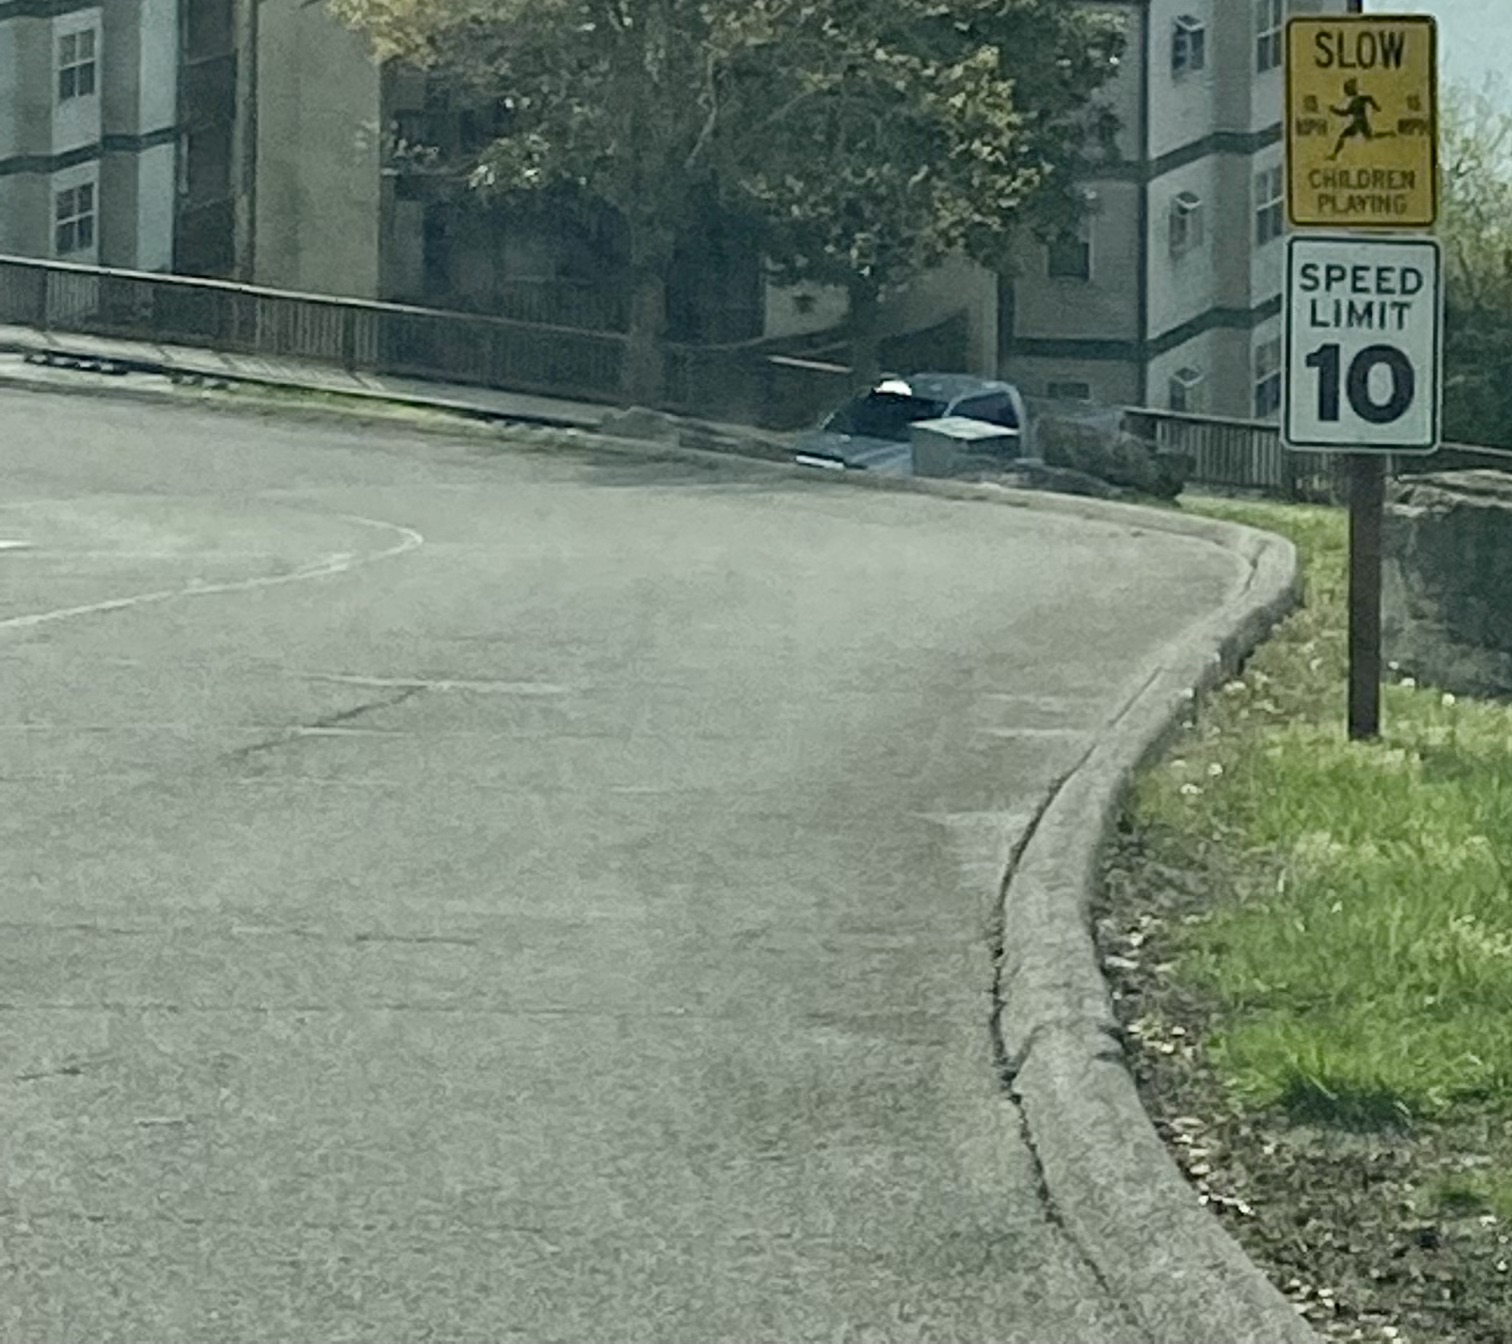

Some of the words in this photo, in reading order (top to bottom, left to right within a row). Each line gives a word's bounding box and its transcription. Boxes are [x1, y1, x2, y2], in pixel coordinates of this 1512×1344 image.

[1315, 31, 1405, 69] SLOW
[1308, 168, 1416, 190] CHILDREN
[1318, 193, 1407, 215] PLAYING
[1300, 263, 1423, 295] SPEED
[1310, 298, 1412, 330] LIMIT
[1305, 343, 1415, 424] 10
